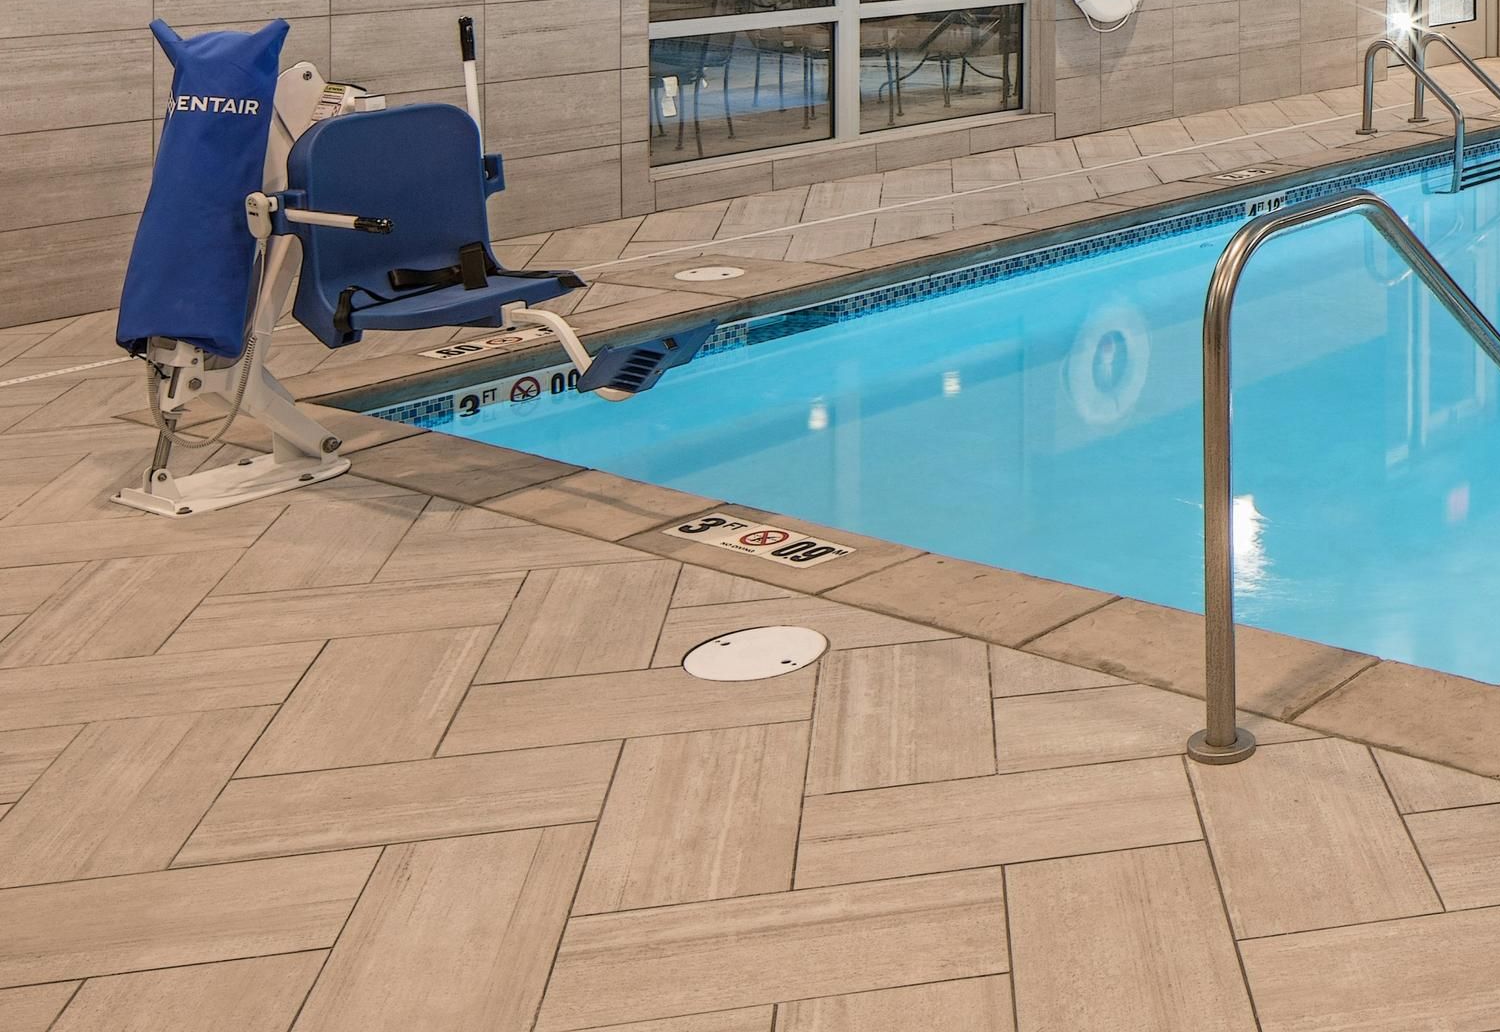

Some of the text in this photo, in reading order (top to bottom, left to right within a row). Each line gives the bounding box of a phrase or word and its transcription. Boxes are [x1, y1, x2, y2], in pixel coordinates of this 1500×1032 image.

[459, 394, 480, 418] 3
[482, 388, 498, 404] FT
[678, 517, 727, 534] 3
[723, 522, 749, 531] FT
